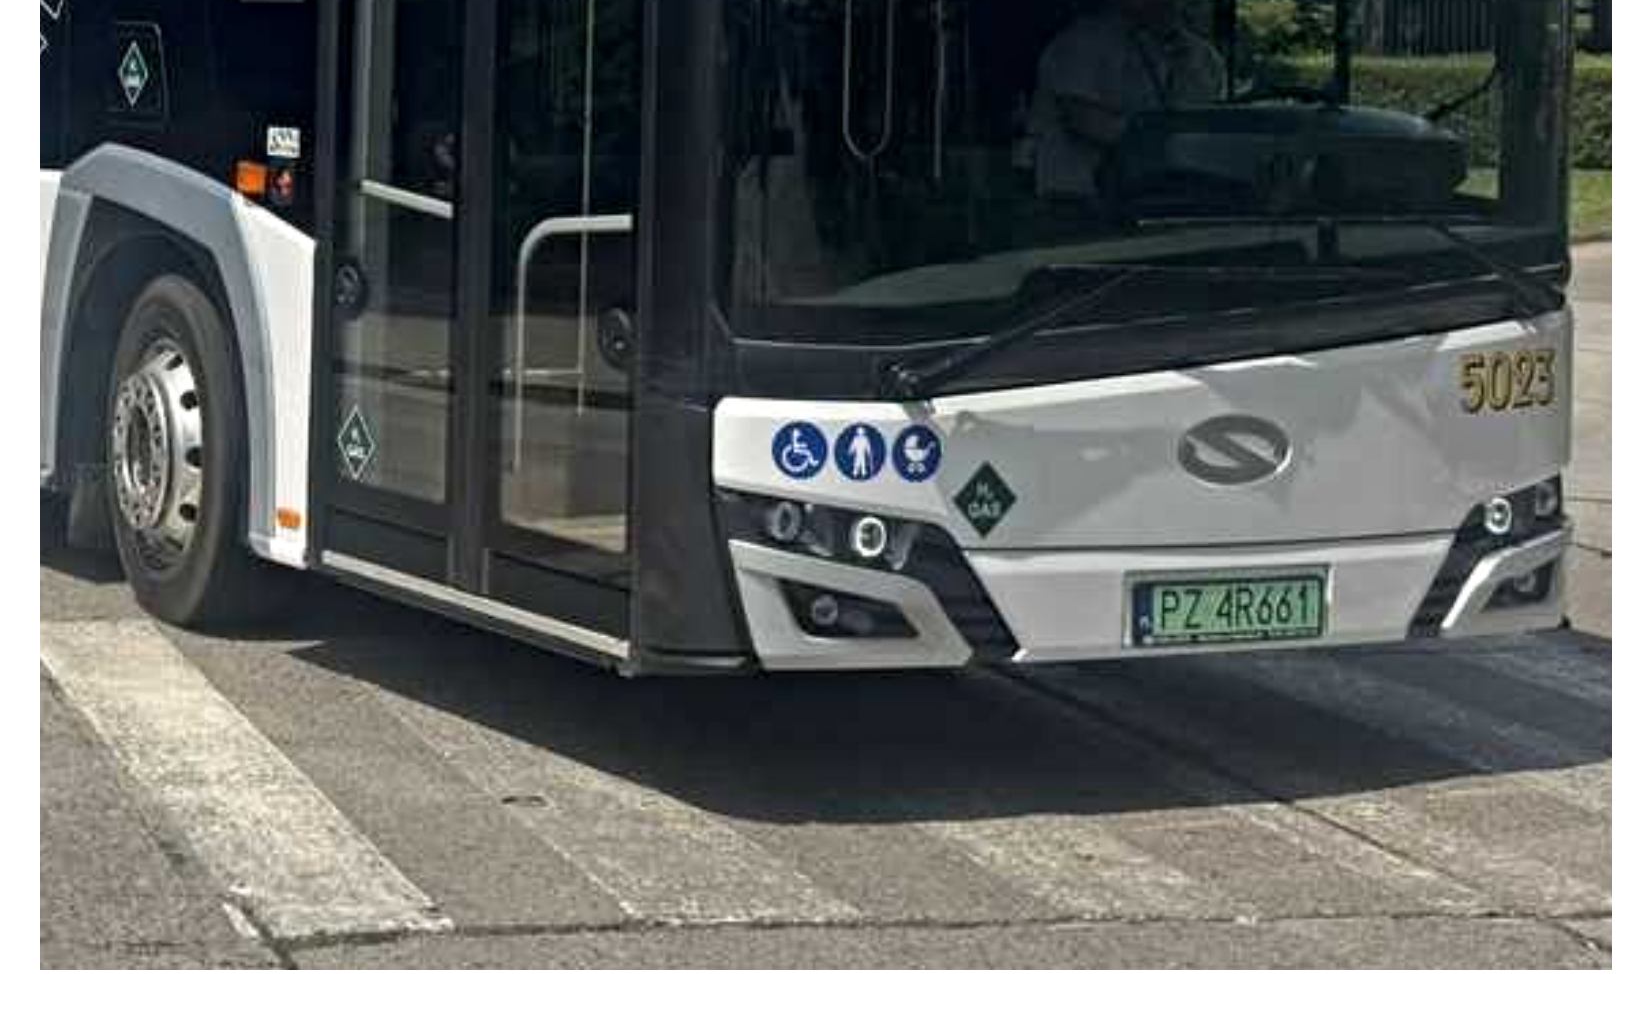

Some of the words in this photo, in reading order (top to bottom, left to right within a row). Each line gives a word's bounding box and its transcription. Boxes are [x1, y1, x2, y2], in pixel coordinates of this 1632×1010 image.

[1459, 350, 1556, 414] 5023
[1161, 589, 1203, 631] PZ
[1215, 583, 1308, 627] 4R661
